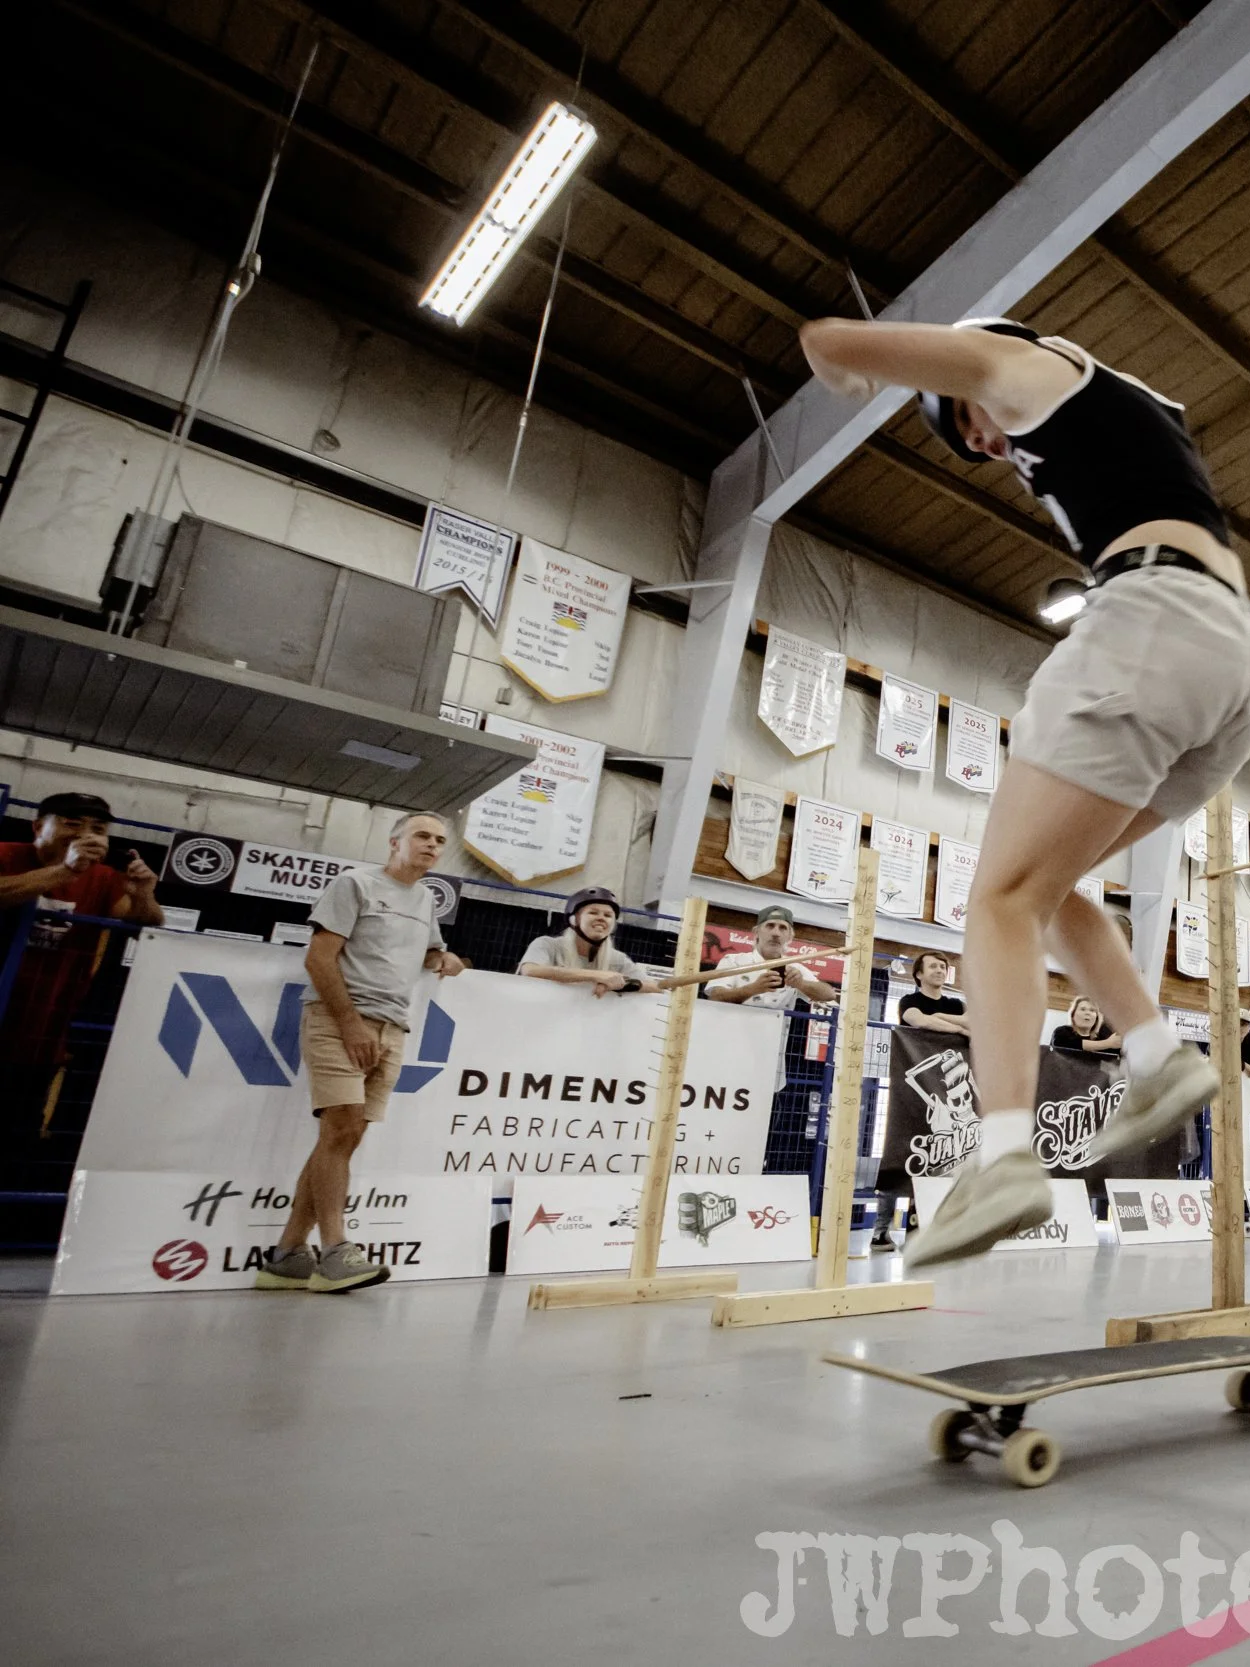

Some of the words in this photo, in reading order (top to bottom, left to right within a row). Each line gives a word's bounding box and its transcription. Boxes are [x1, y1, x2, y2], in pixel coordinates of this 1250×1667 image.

[436, 523, 504, 556] CHAMPIONS
[474, 530, 505, 547] VALLY
[545, 560, 571, 576] 1999
[583, 575, 609, 592] 2000
[904, 694, 923, 710] 025
[439, 710, 472, 726] ALEY
[963, 716, 987, 734] 2025
[814, 813, 844, 832] 2024
[888, 833, 913, 849] 2024
[246, 848, 355, 877] SKATEB
[954, 854, 977, 869] 2023
[875, 1042, 889, 1054] 50
[457, 1067, 752, 1113] DIMENSONS
[843, 1096, 858, 1106] 20
[449, 1112, 687, 1143] FABRICATIG
[443, 1150, 742, 1176] MANUFACTRING
[365, 1186, 409, 1210] Inn
[566, 1215, 584, 1223] ACE
[1116, 1204, 1146, 1219] BONES
[555, 1223, 593, 1231] CUSTOM
